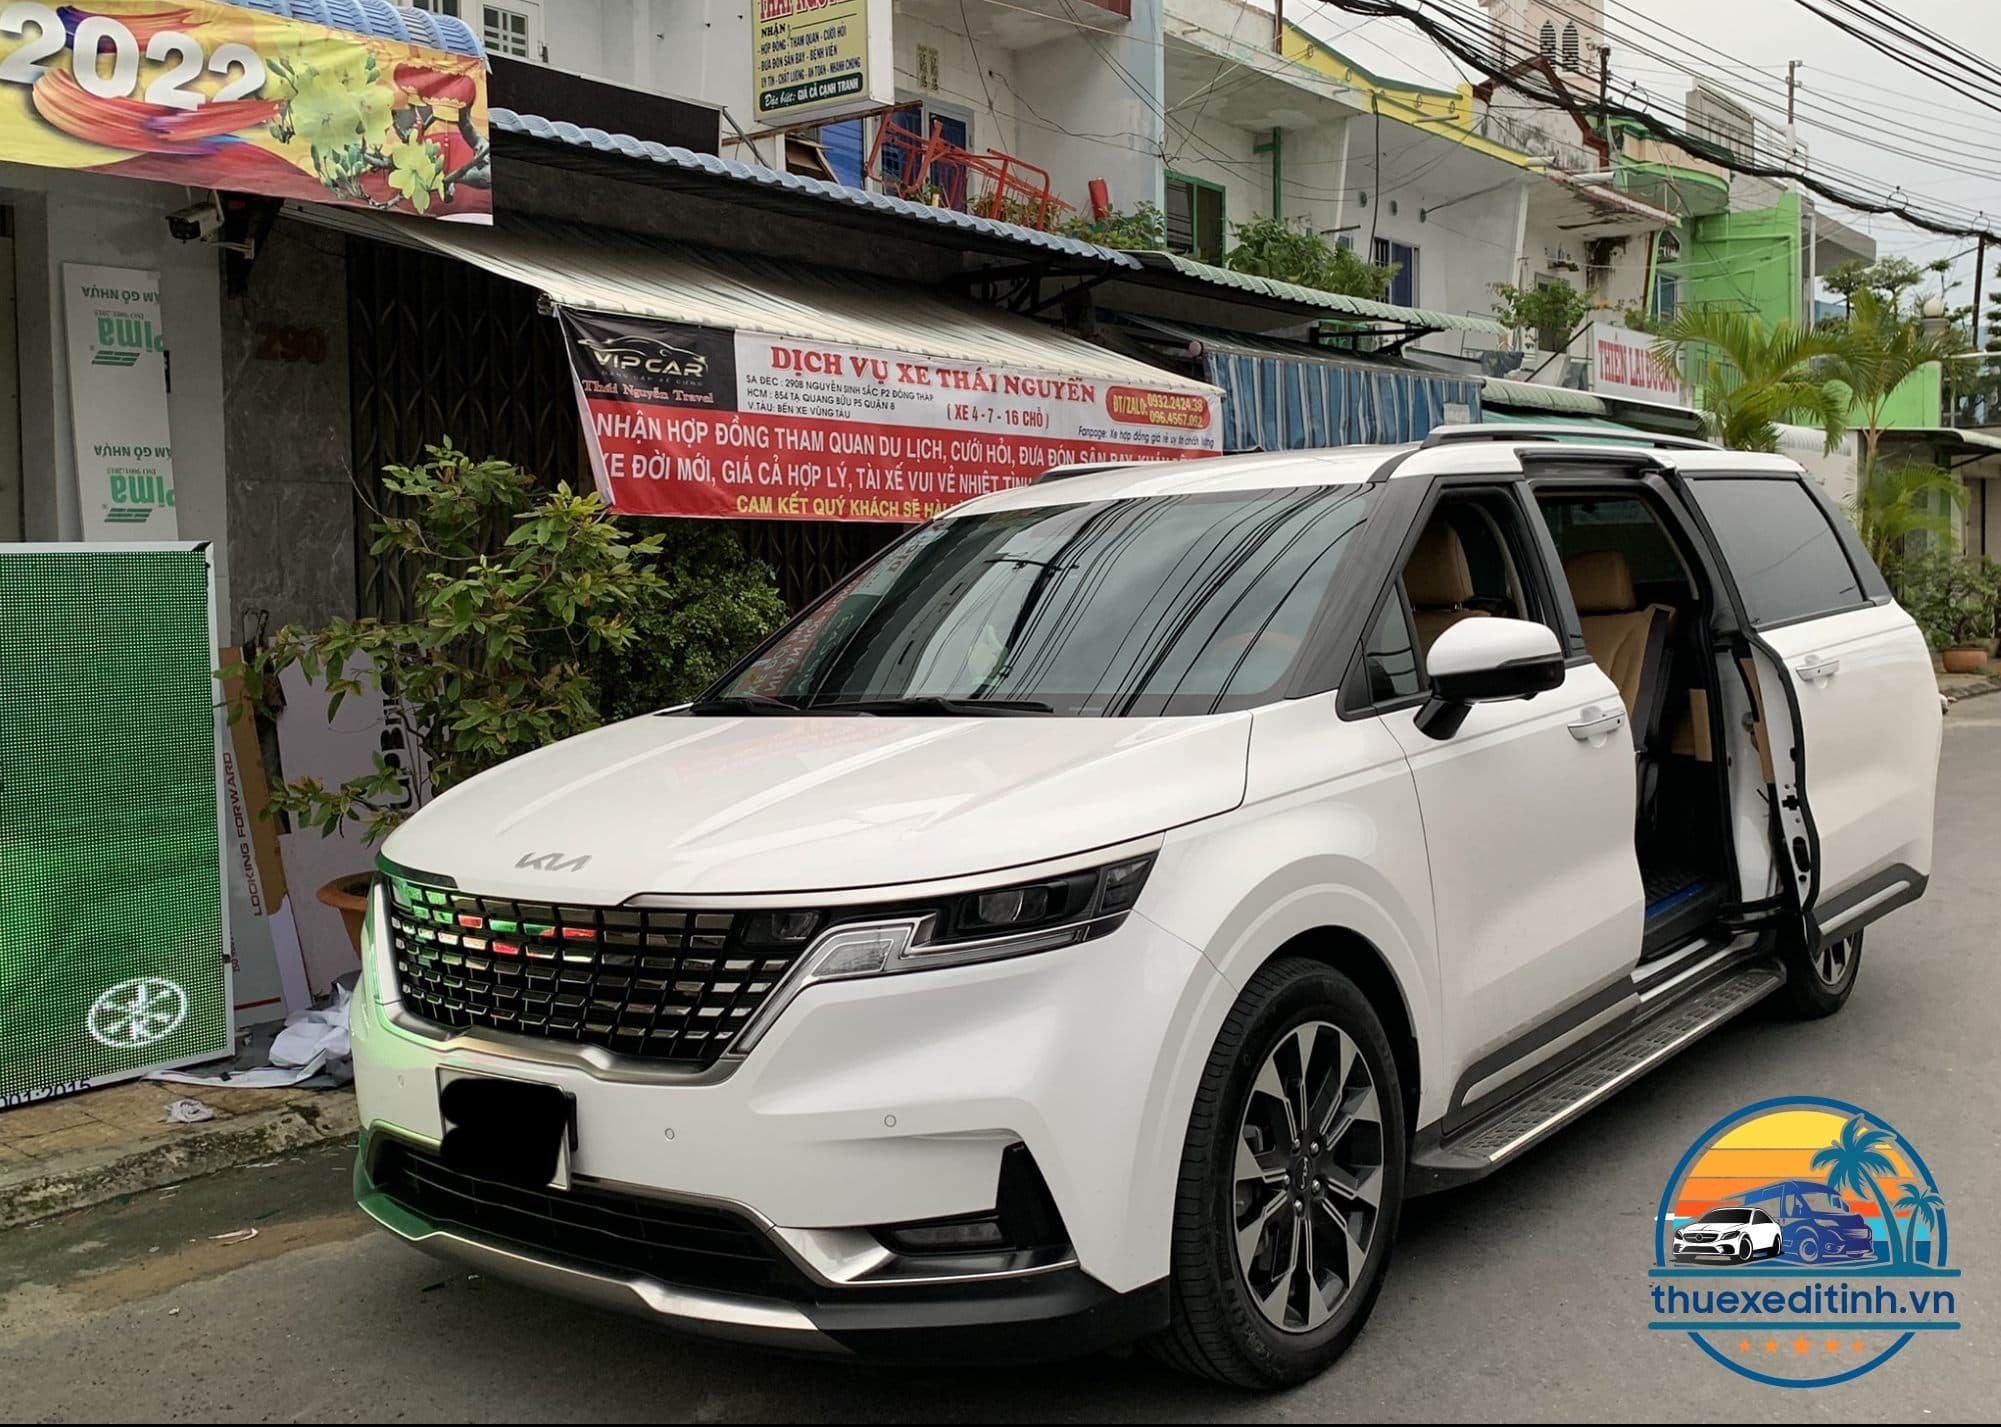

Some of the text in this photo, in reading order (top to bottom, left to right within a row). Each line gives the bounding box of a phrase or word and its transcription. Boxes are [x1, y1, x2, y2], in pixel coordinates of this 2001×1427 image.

[0, 2, 267, 112] 2022
[837, 78, 859, 92] TRANH
[771, 346, 1095, 403] DỊCH VỤ XE THÁI NGUYỄN
[672, 389, 714, 404] Travel
[747, 388, 767, 399] HCM
[802, 393, 834, 405] QUANG
[795, 405, 807, 415] XE
[972, 406, 978, 422] 4
[988, 408, 994, 424] 7
[1005, 409, 1019, 426] 16
[597, 410, 662, 444] NHẬN
[667, 417, 709, 447] HỢP
[715, 415, 769, 448] ĐỒNG
[774, 427, 824, 452] THAM
[828, 431, 875, 456] QUAN
[880, 435, 901, 458] DU
[906, 437, 947, 463] LỊCH,
[951, 436, 983, 462] CƯỚI
[986, 436, 1015, 468] HỎI,
[1019, 444, 1045, 466] ĐƯA
[1048, 444, 1075, 467] ĐÓN
[632, 448, 670, 480] ĐỜI
[677, 451, 716, 486] MỚI,
[722, 459, 752, 485] GIÁ
[758, 454, 783, 486] CẢ
[788, 462, 822, 492] HỢP
[826, 461, 853, 492] LÝ,
[856, 462, 881, 490] TÀI
[885, 461, 904, 491] XẾ
[908, 470, 933, 493] VUI
[938, 465, 955, 494] VẺ
[737, 495, 773, 514] CAM
[778, 491, 808, 515] KẾT
[813, 493, 846, 516] QUÝ
[850, 497, 899, 517] KHÁCH
[903, 498, 921, 518] SẼ
[222, 752, 263, 917] LOOKING FORWARD
